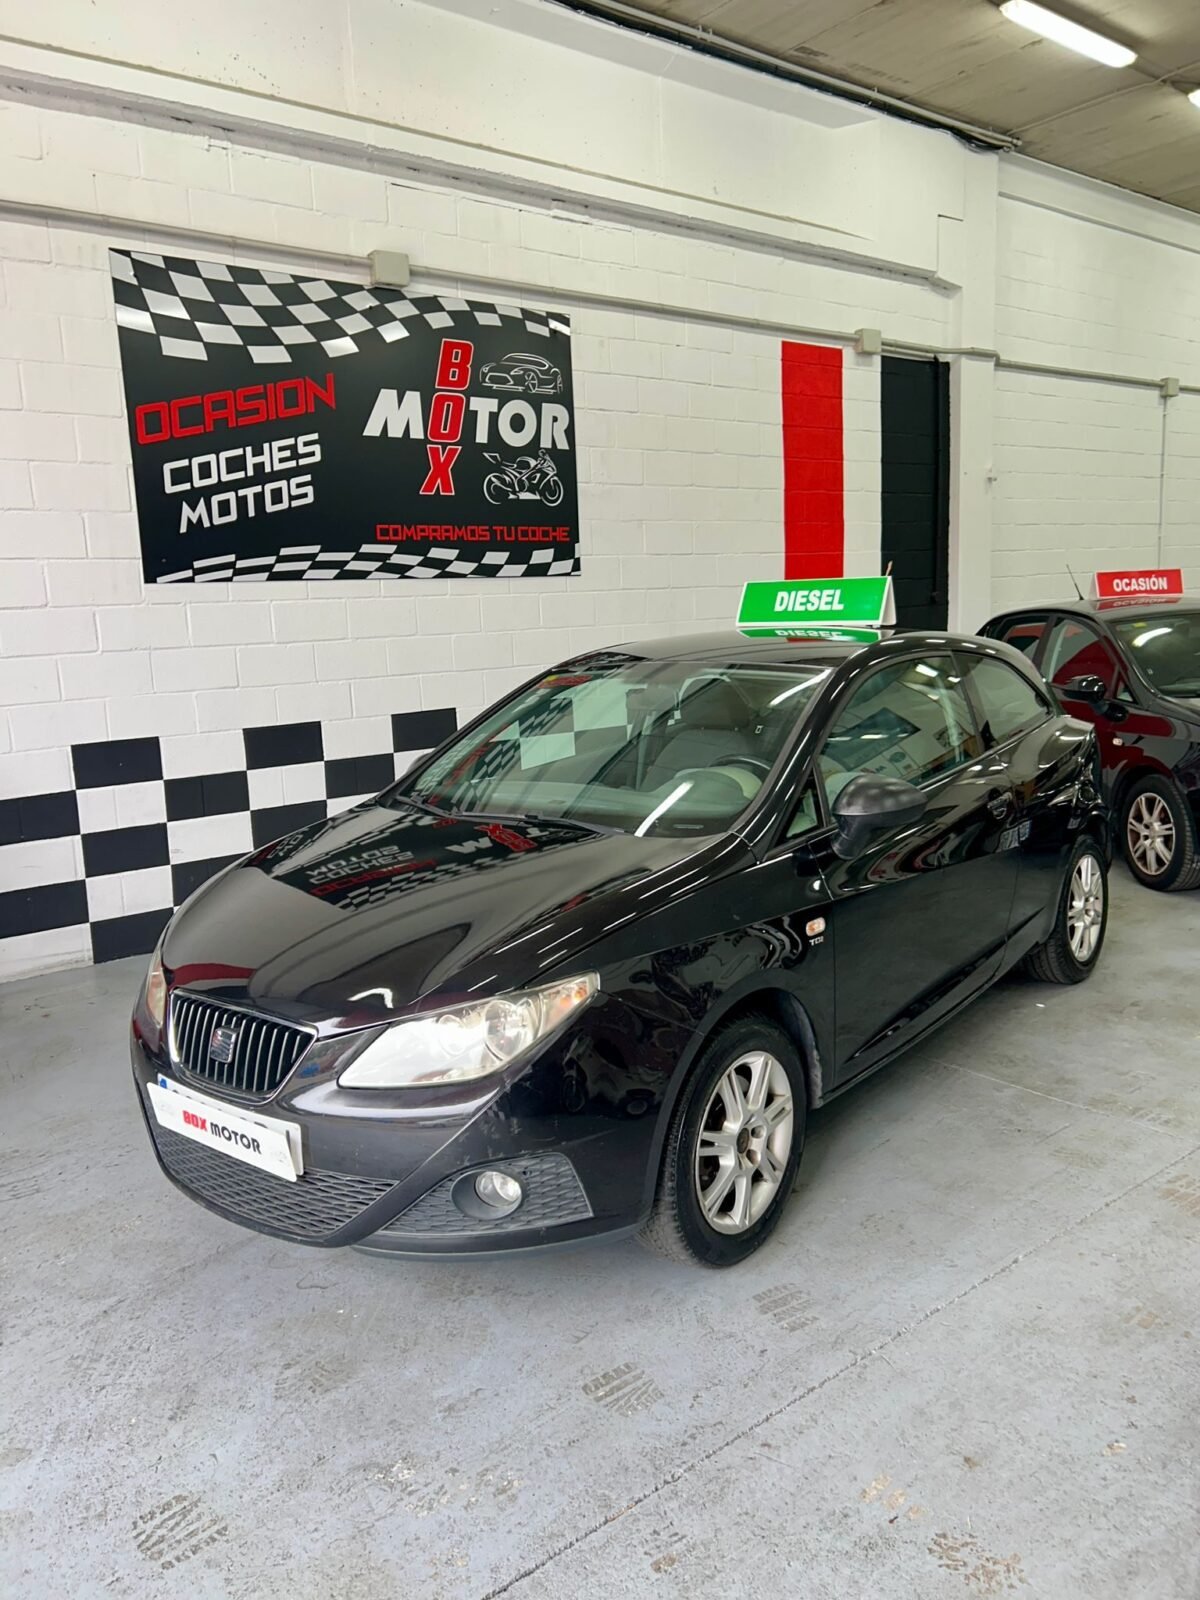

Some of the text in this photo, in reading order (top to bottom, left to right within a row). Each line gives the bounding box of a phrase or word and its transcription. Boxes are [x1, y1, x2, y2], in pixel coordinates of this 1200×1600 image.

[135, 372, 336, 444] OCASION
[419, 338, 474, 495] BOX
[163, 432, 321, 494] COCHES
[179, 474, 314, 533] MOTOS
[376, 524, 570, 542] COMPRAMOS TU COCHE
[1113, 574, 1168, 592] OCASIÓN
[773, 589, 845, 612] DIESEL
[809, 935, 824, 946] TDI
[183, 1109, 208, 1132] BOX
